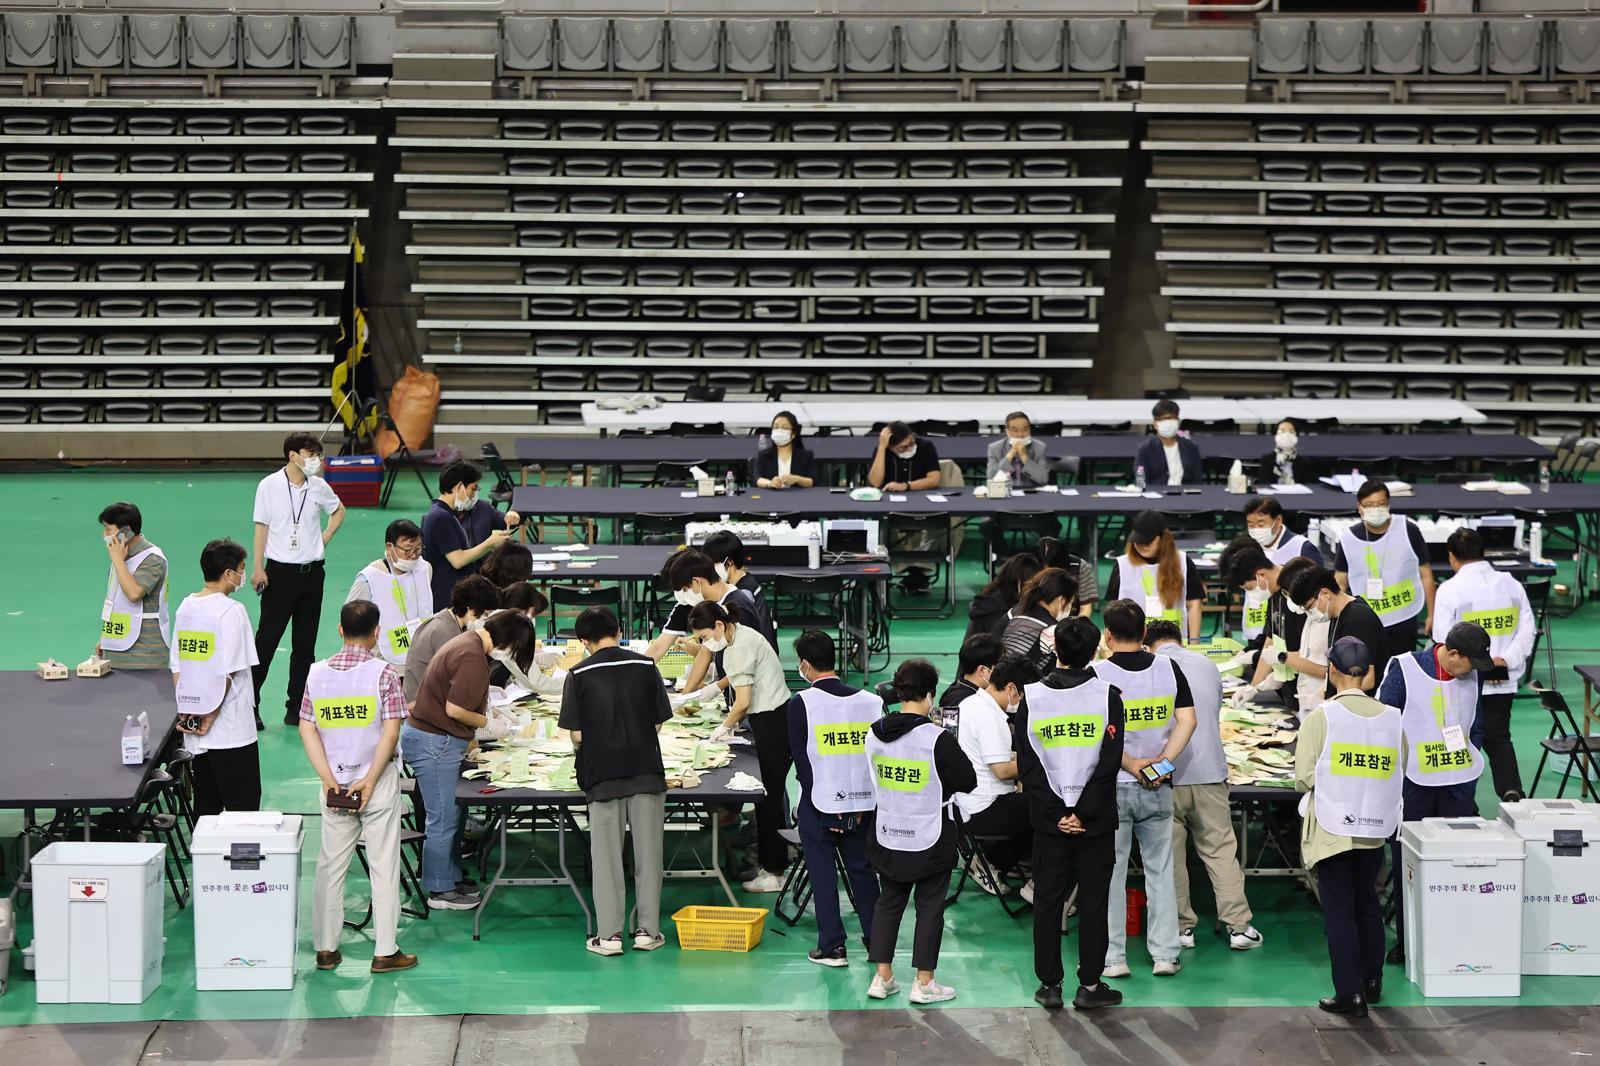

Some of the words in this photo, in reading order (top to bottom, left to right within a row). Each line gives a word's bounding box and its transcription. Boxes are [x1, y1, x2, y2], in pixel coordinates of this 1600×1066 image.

[320, 704, 369, 721] 개표참관
[1040, 722, 1096, 740] 개표참관
[1424, 743, 1448, 752] 질서있
[1339, 752, 1392, 772] 개표참관
[202, 885, 230, 893] 민주주의
[1429, 884, 1457, 892] 민주주의
